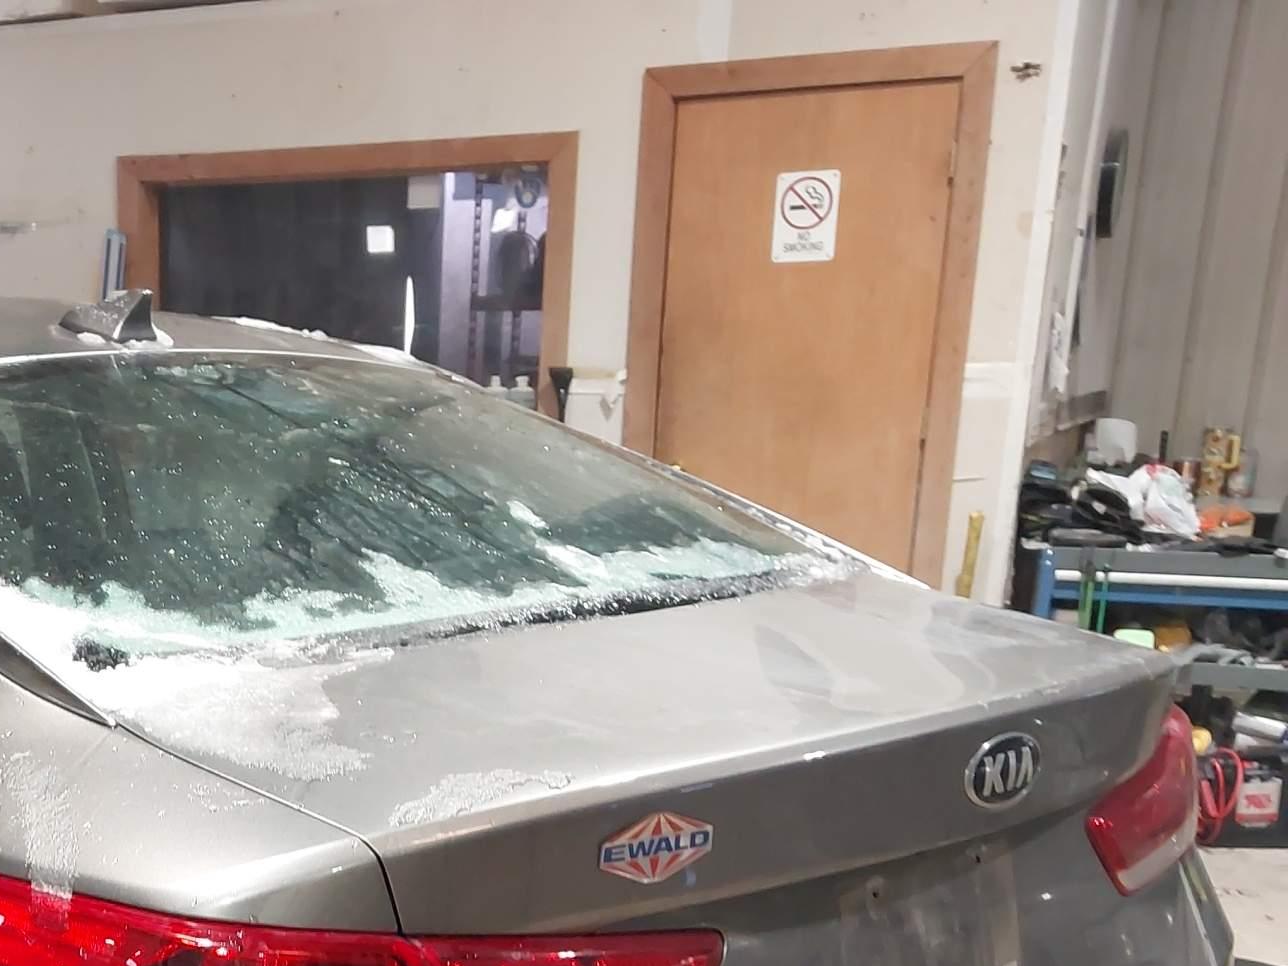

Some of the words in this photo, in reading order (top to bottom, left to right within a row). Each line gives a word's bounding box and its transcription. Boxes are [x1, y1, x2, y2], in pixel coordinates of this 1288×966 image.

[783, 241, 824, 253] SMOKING
[797, 231, 811, 241] NO
[982, 745, 1033, 797] KIA
[603, 830, 710, 863] EWALD
